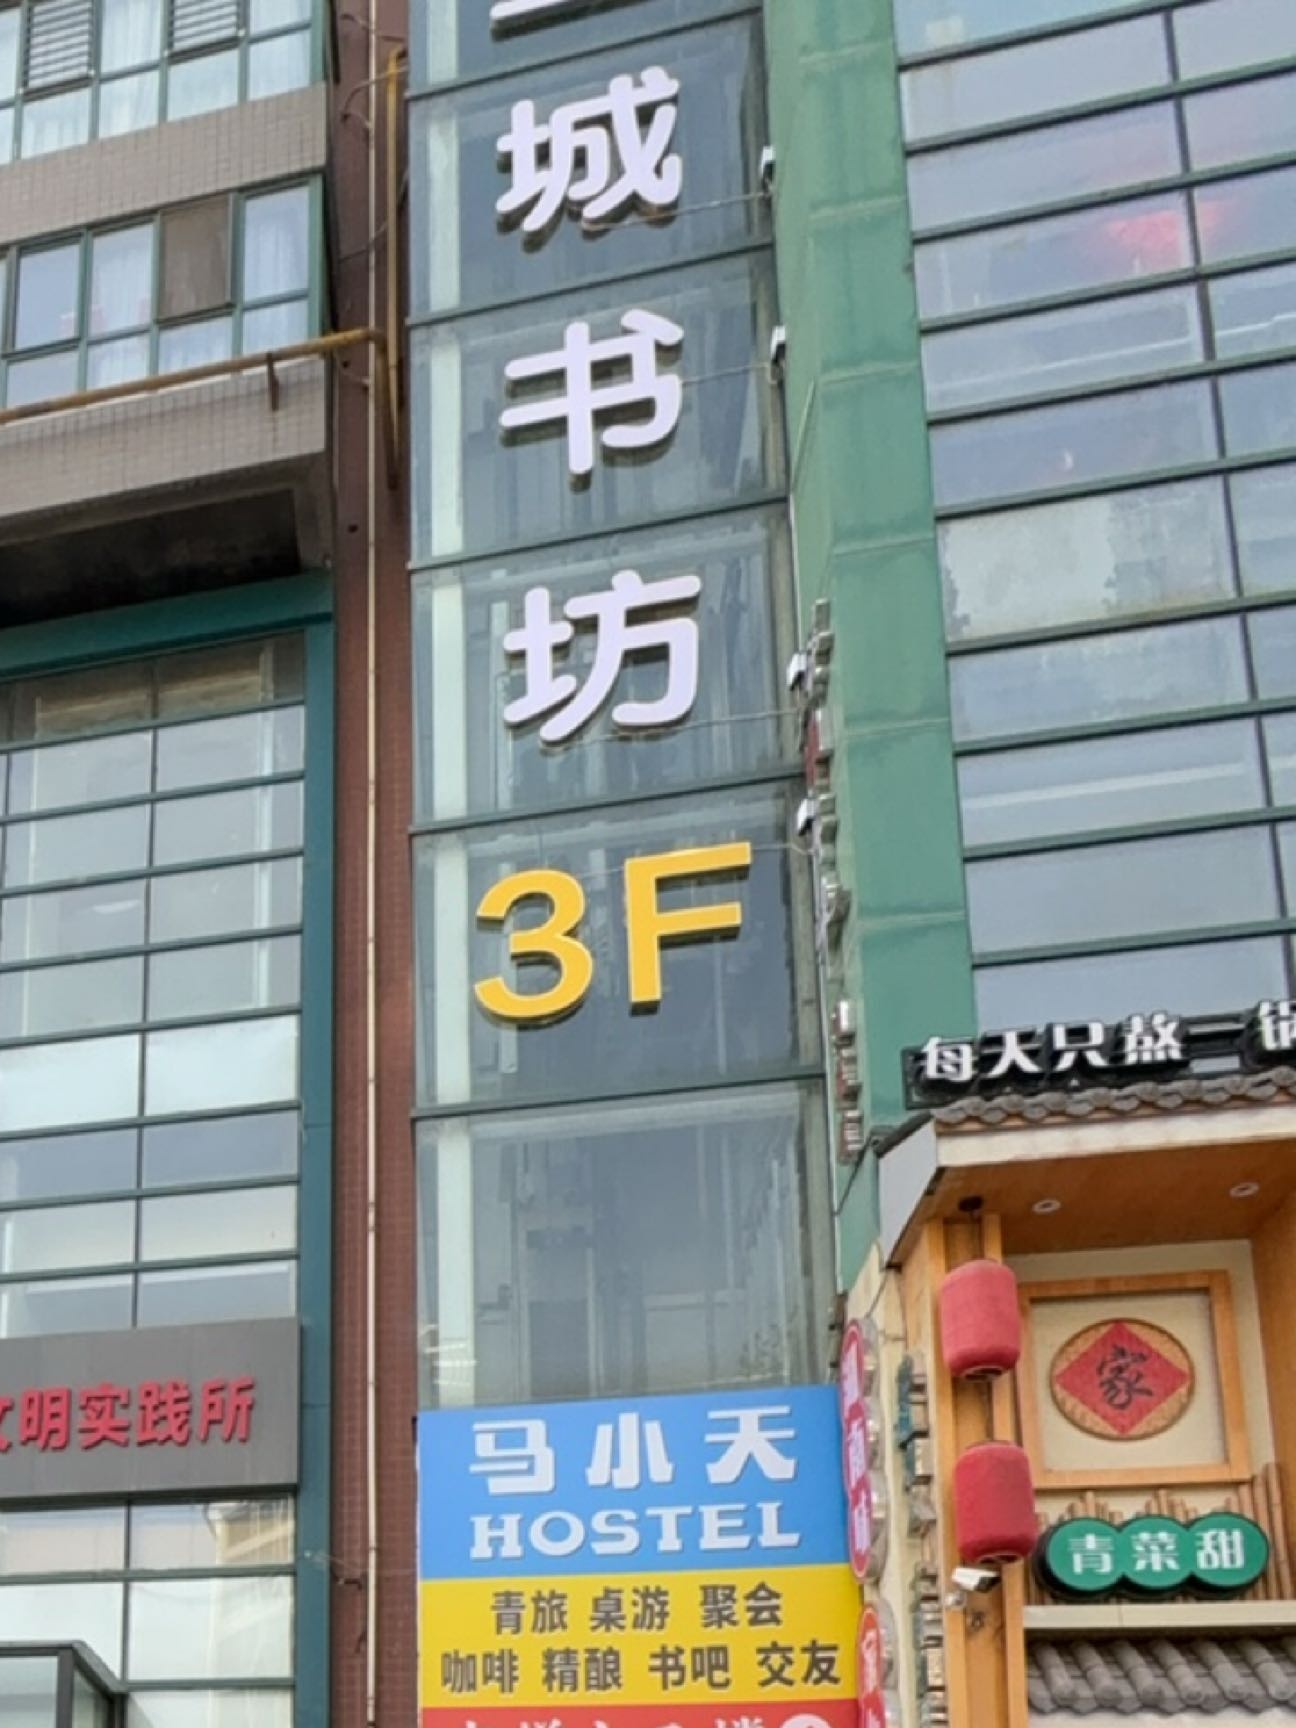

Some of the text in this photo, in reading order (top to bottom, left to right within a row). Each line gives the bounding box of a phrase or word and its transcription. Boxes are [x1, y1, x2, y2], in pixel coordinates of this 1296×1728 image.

[491, 0, 702, 744] 城书坊
[474, 842, 752, 1020] 3F
[469, 1405, 797, 1496] 马小天
[470, 1502, 800, 1560] HOSTEL
[1067, 1528, 1245, 1576] 青菜甜
[491, 1582, 783, 1636] 青旅 桌游 聚会
[441, 1640, 842, 1694] 咖啡 精酿 书吧 交友
